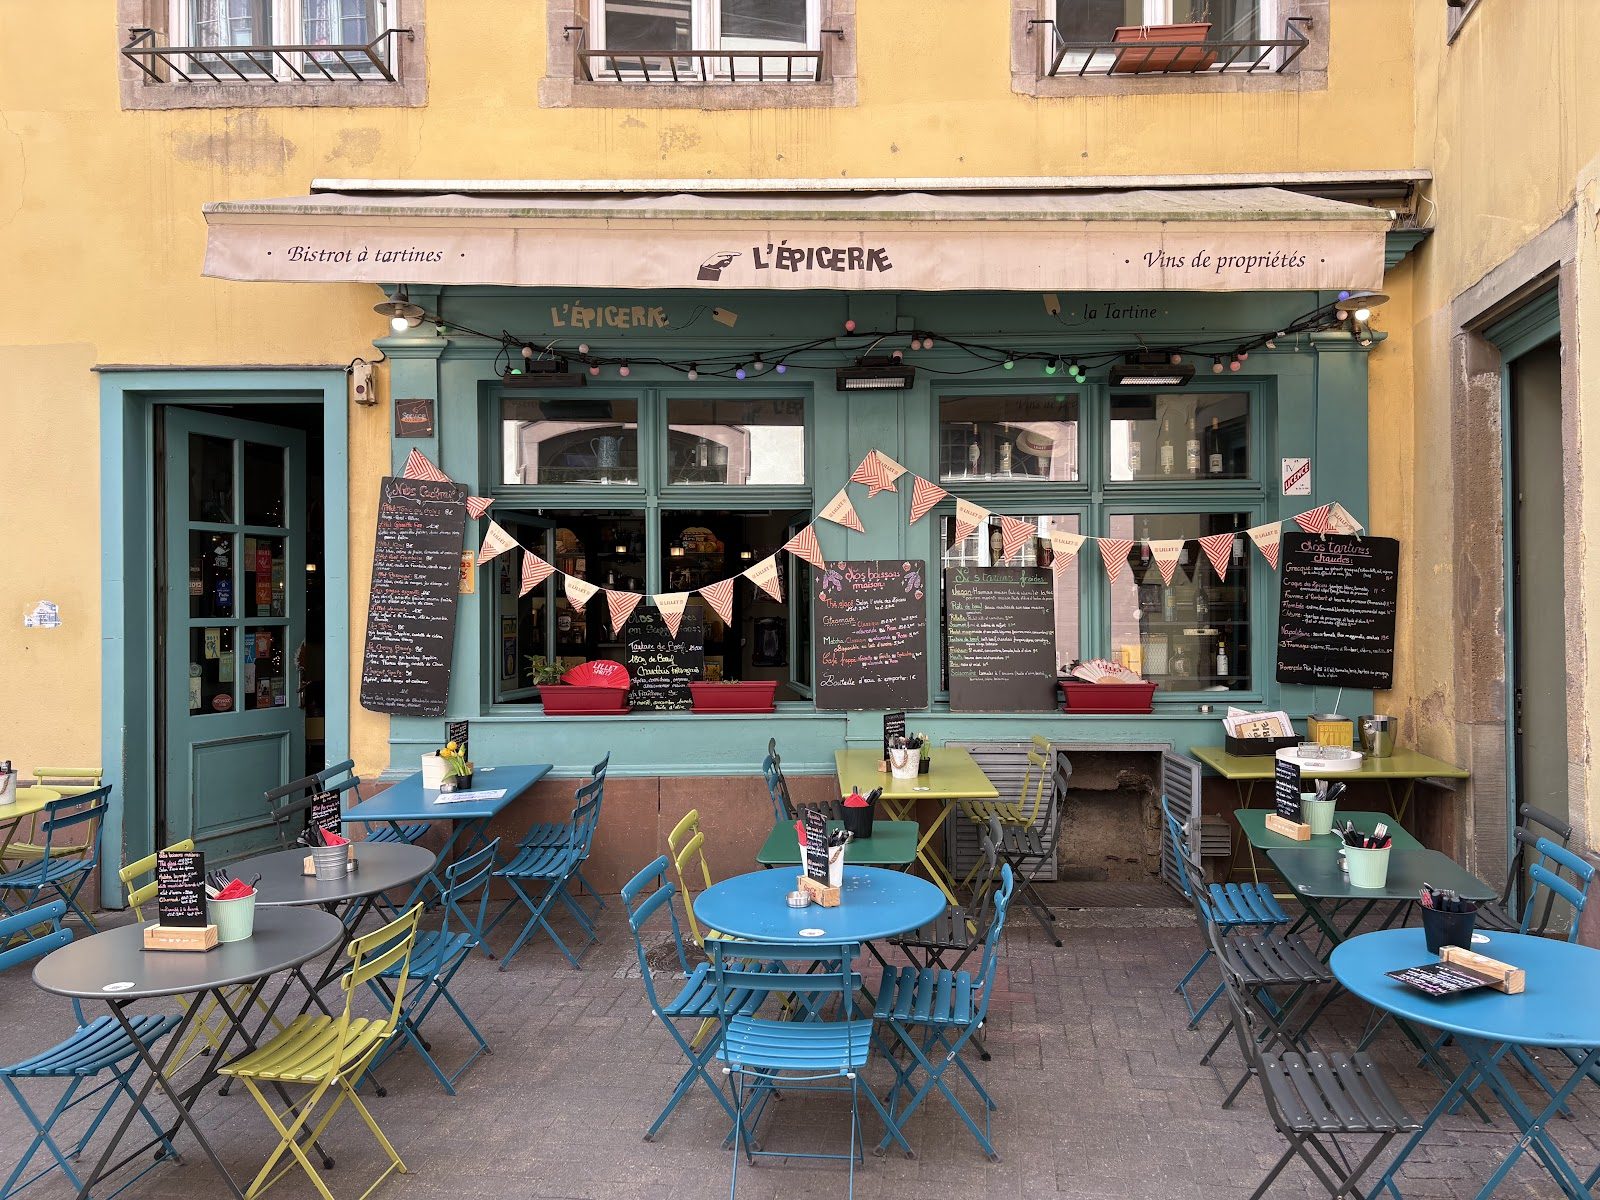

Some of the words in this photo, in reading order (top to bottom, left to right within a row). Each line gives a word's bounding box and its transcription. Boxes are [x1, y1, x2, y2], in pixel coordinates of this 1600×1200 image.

[287, 245, 352, 263] Bistrot
[357, 246, 369, 263] à
[374, 246, 443, 263] tartines
[752, 239, 893, 273] L'ÉPICERIE
[1143, 249, 1186, 268] Vins
[1191, 249, 1211, 268] de
[1215, 250, 1306, 274] propriétés
[1084, 304, 1097, 319] la
[1104, 303, 1157, 318] Tartine
